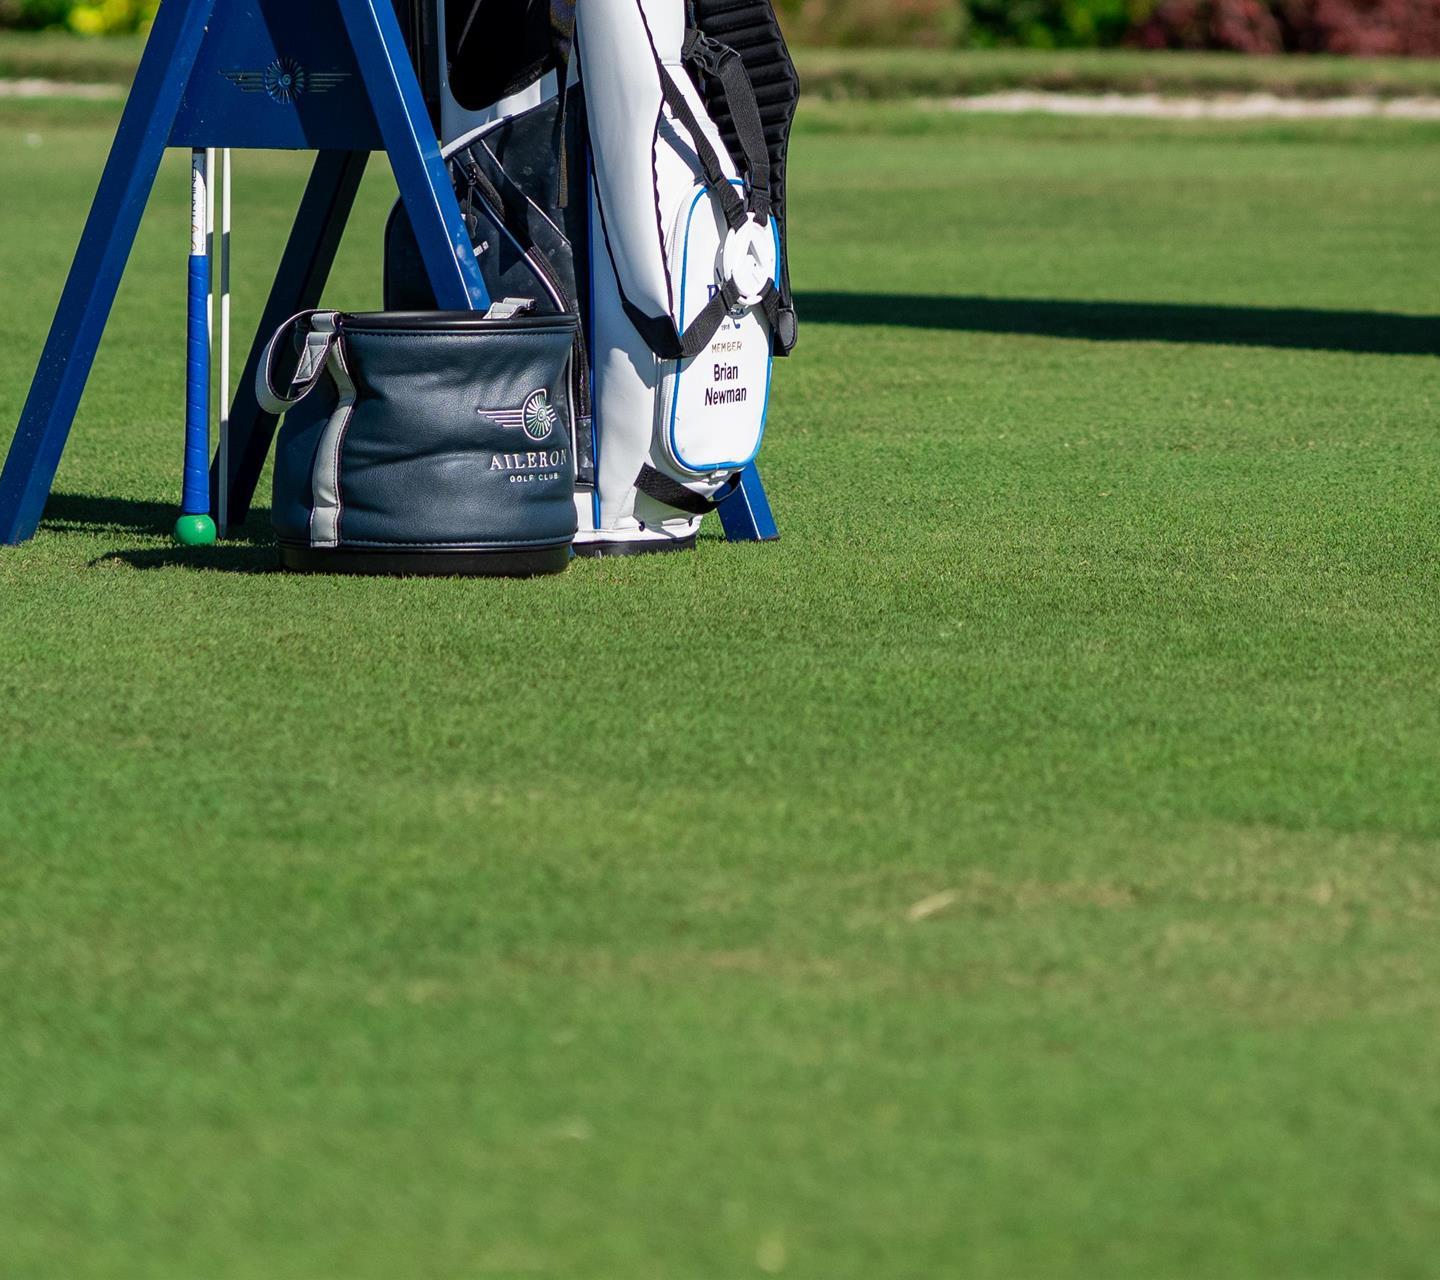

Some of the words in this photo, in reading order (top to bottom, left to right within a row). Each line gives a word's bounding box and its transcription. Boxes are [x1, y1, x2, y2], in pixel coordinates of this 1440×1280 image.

[711, 341, 743, 354] MEMBER
[713, 362, 739, 382] Brian
[704, 387, 747, 407] Newman
[490, 448, 567, 471] AILERON
[509, 474, 534, 483] GOLF
[538, 472, 559, 481] CLUB
